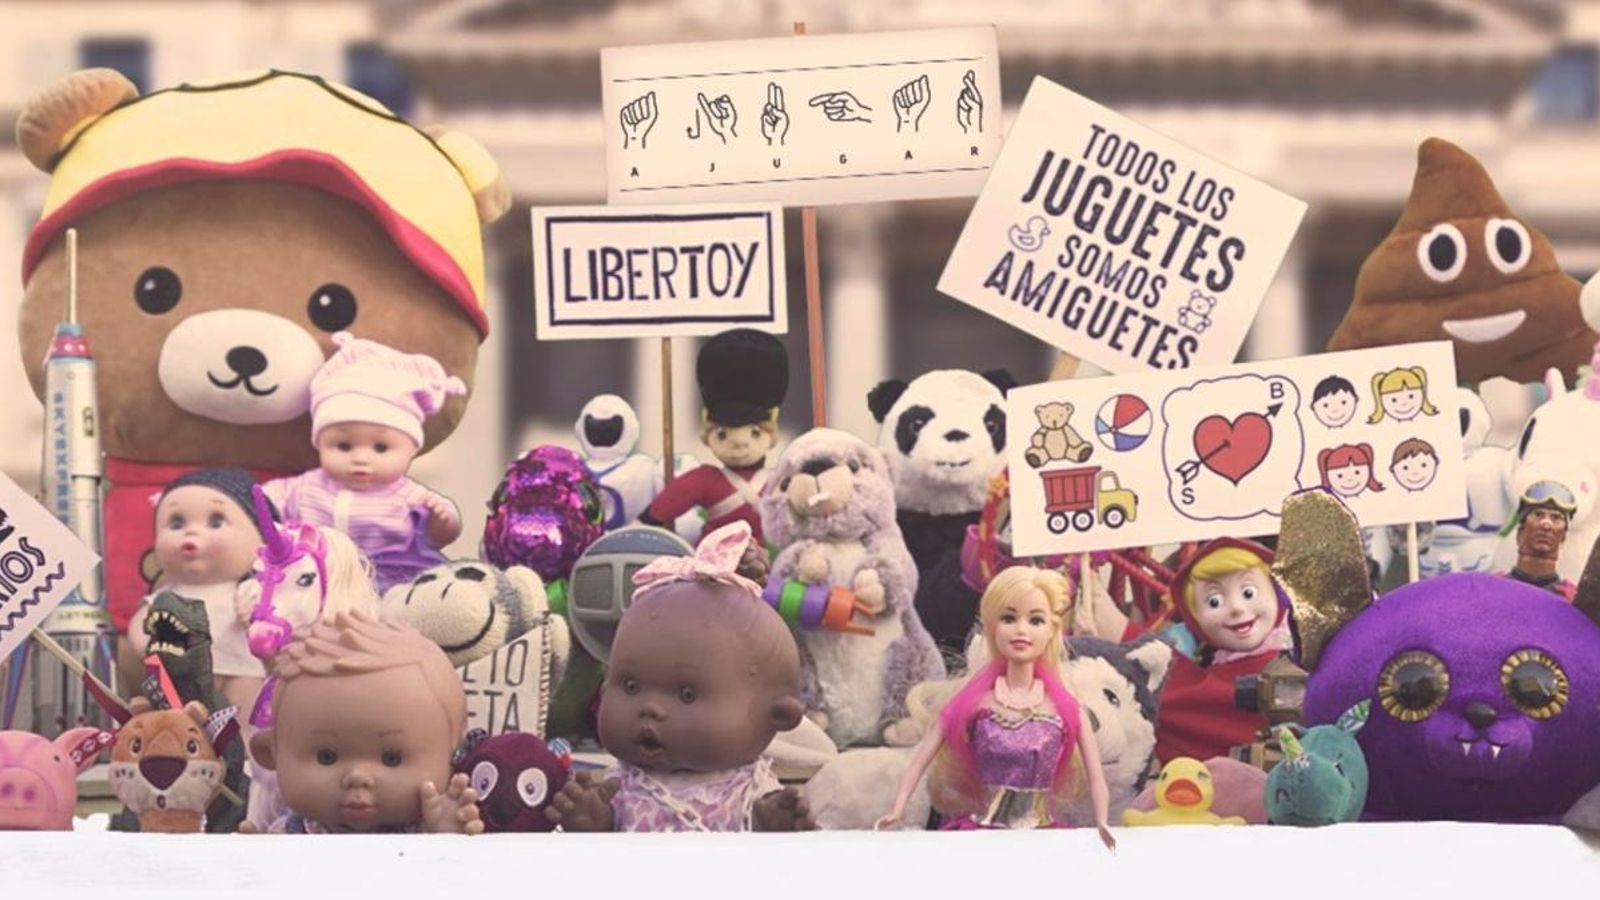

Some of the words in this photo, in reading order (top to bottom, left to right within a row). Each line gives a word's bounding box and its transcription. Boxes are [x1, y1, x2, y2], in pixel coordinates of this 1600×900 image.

[630, 166, 640, 178] A
[708, 162, 716, 173] J
[772, 157, 782, 169] U
[838, 153, 848, 165] G
[904, 150, 914, 161] A
[970, 145, 980, 157] R
[1082, 123, 1177, 195] TODOS
[1177, 169, 1235, 222] LOS
[1020, 149, 1247, 293] JUGUETES
[562, 241, 760, 304] LIBERTOY
[1057, 234, 1168, 309] SOMOS
[983, 250, 1199, 370] AMIGUETES
[1270, 381, 1284, 399] B
[1180, 487, 1195, 506] S
[0, 535, 46, 606] IOS
